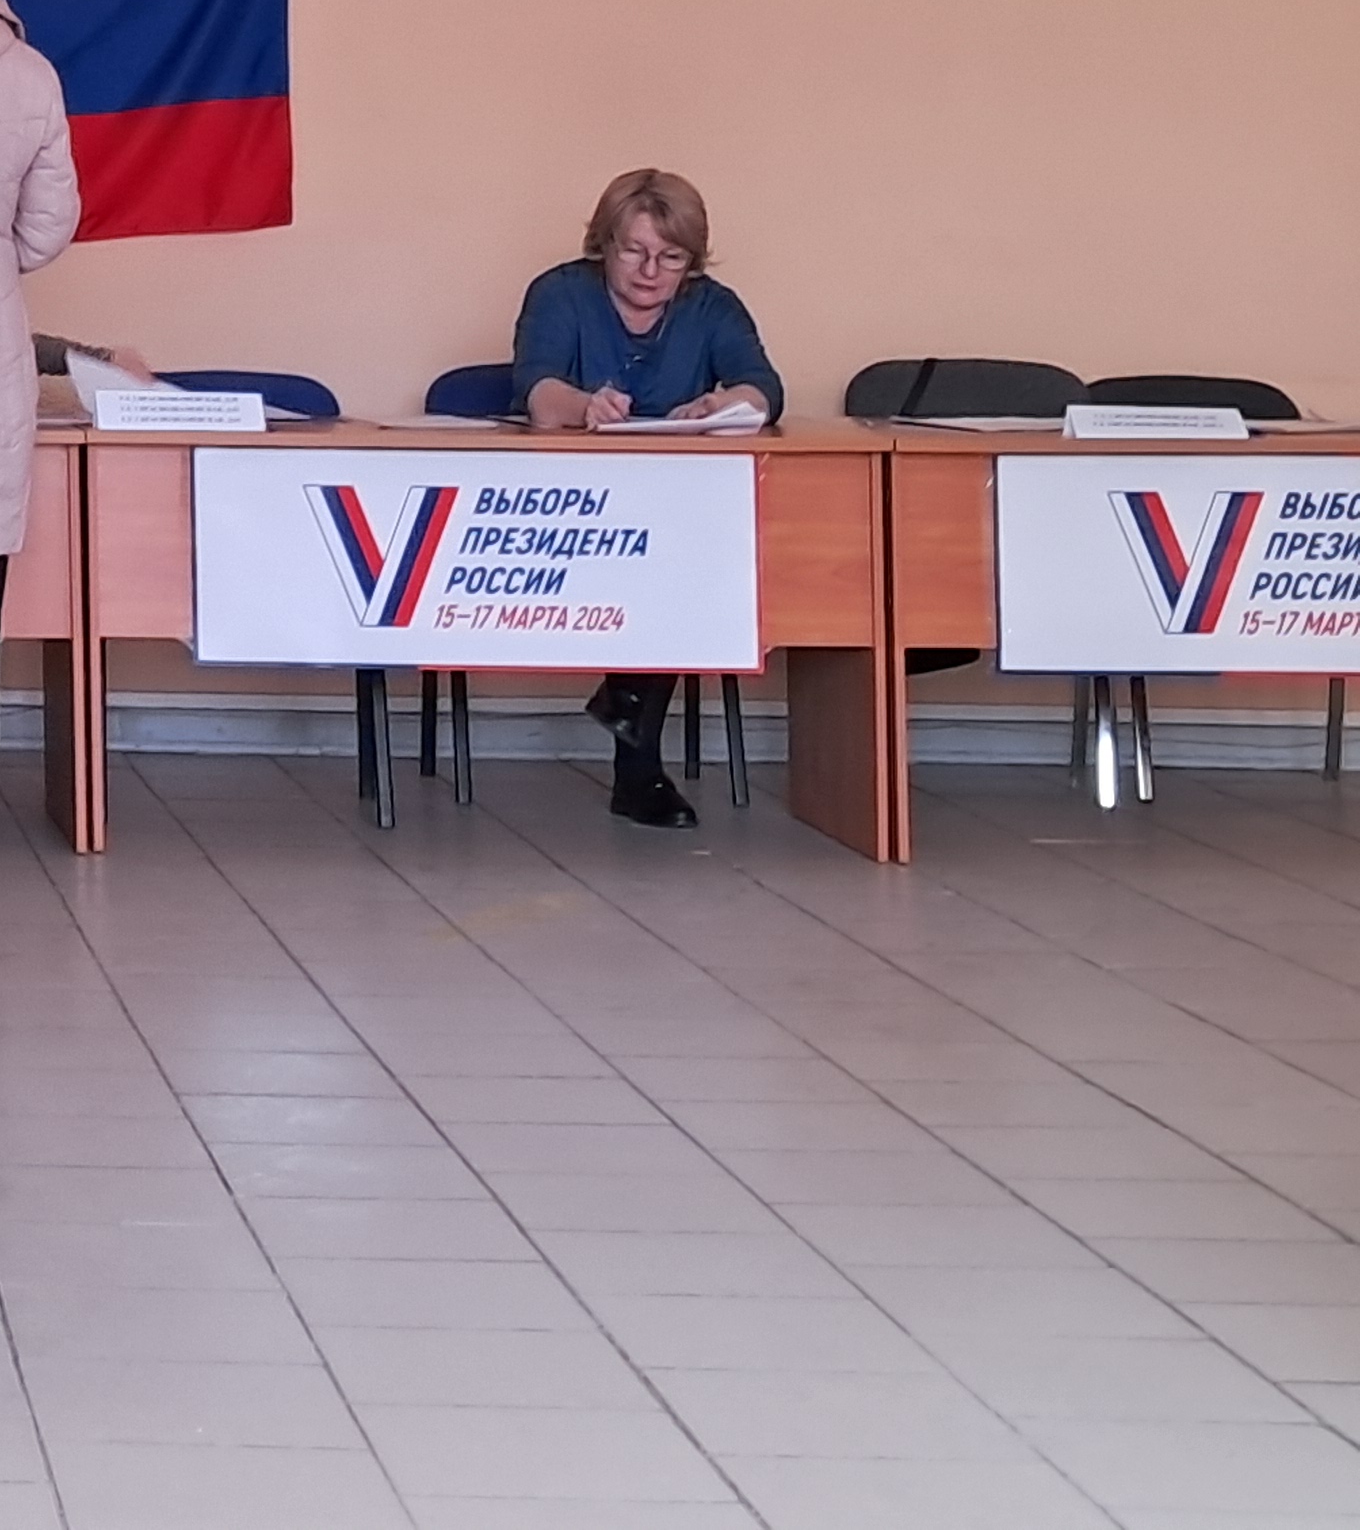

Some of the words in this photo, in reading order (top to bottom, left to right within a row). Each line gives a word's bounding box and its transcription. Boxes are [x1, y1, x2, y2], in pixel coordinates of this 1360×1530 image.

[473, 487, 610, 517] ВЫБОРЫ
[458, 526, 649, 561] ПРЕЗИДЕНТА
[443, 566, 568, 596] РОССИИ
[495, 605, 568, 631] МАРТА
[572, 606, 625, 632] 2024
